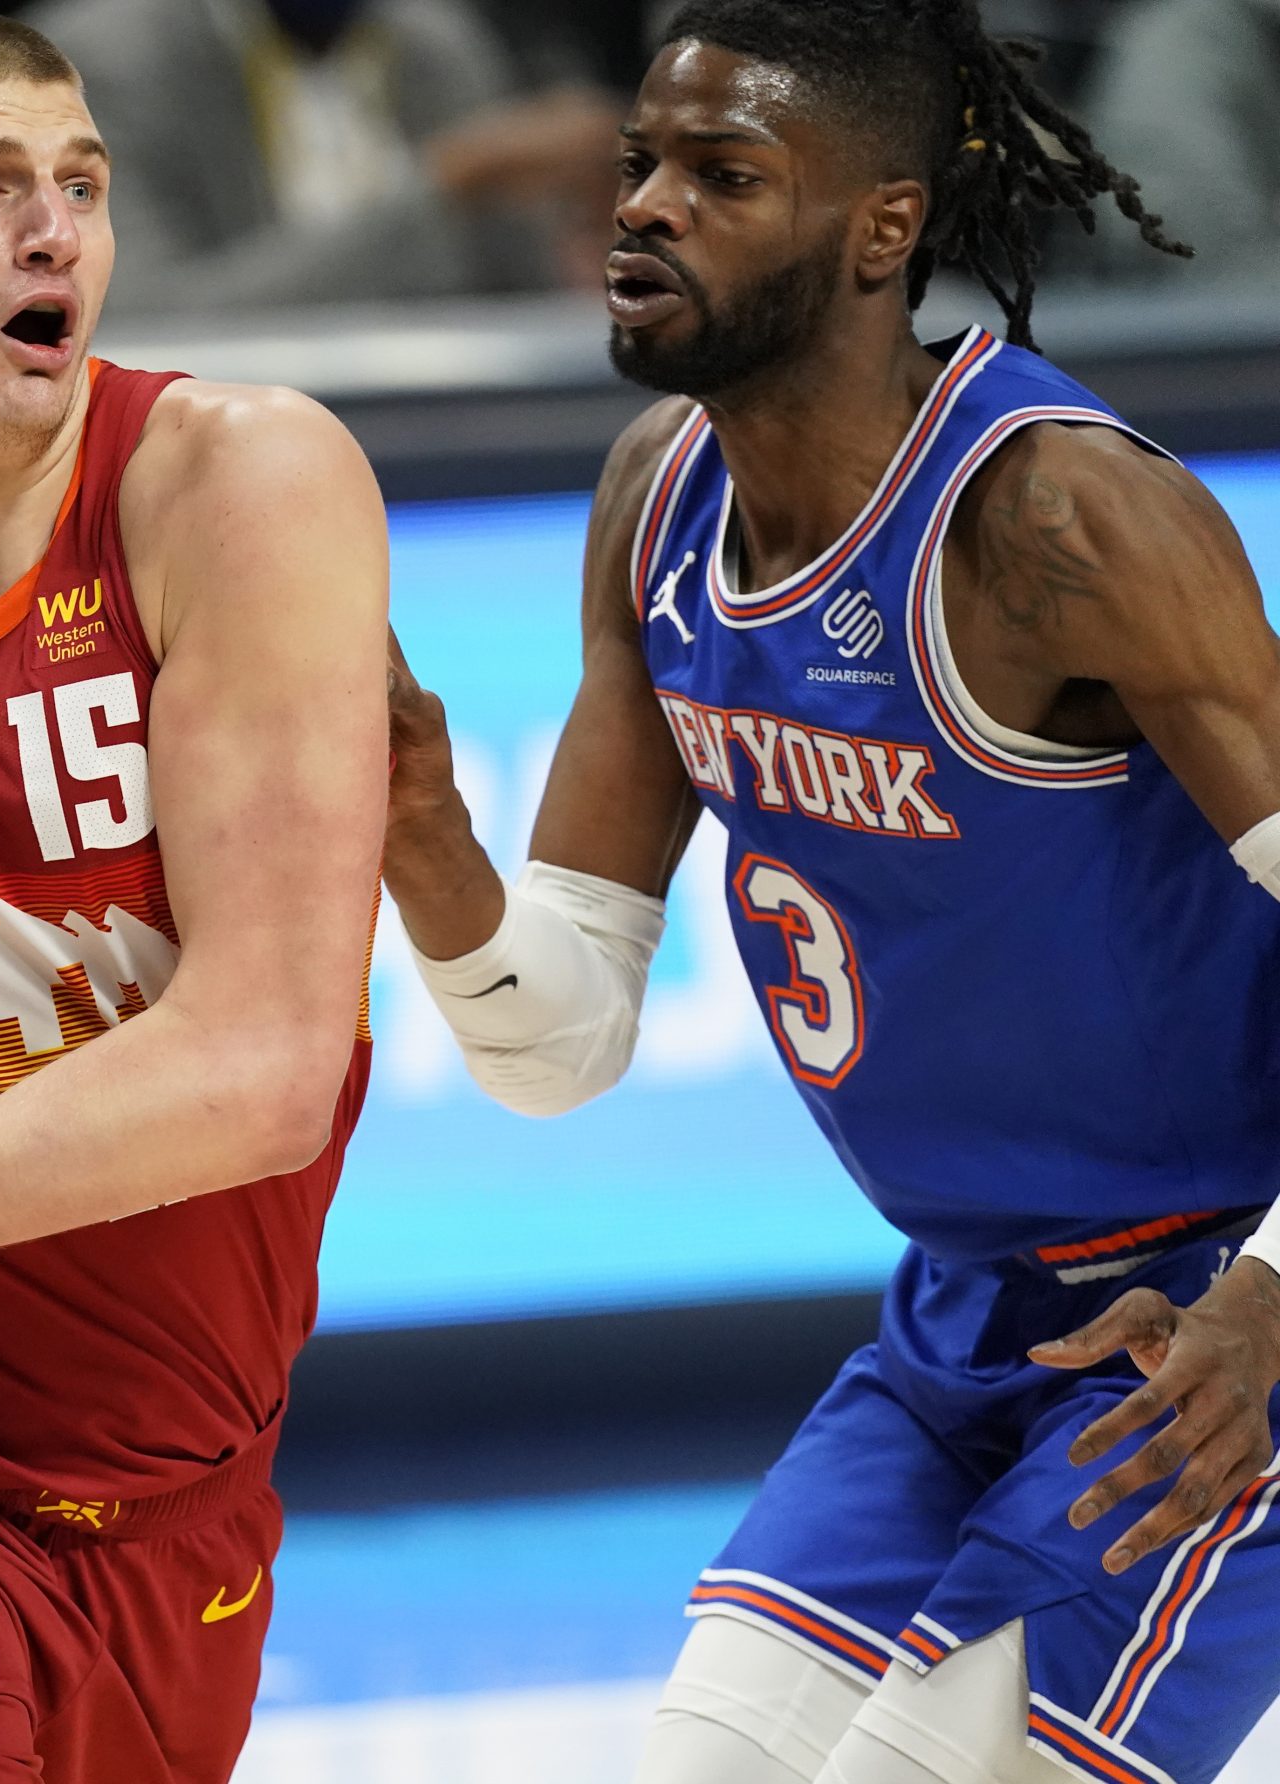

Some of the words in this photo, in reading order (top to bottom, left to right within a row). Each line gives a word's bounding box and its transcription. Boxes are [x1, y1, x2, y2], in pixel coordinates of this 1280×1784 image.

[37, 578, 102, 628] WU
[36, 620, 105, 649] Western
[49, 640, 96, 663] Union
[805, 666, 897, 686] SQUARESPACE
[6, 671, 155, 862] 15
[725, 708, 961, 839] YORK
[732, 852, 865, 1090] 3
